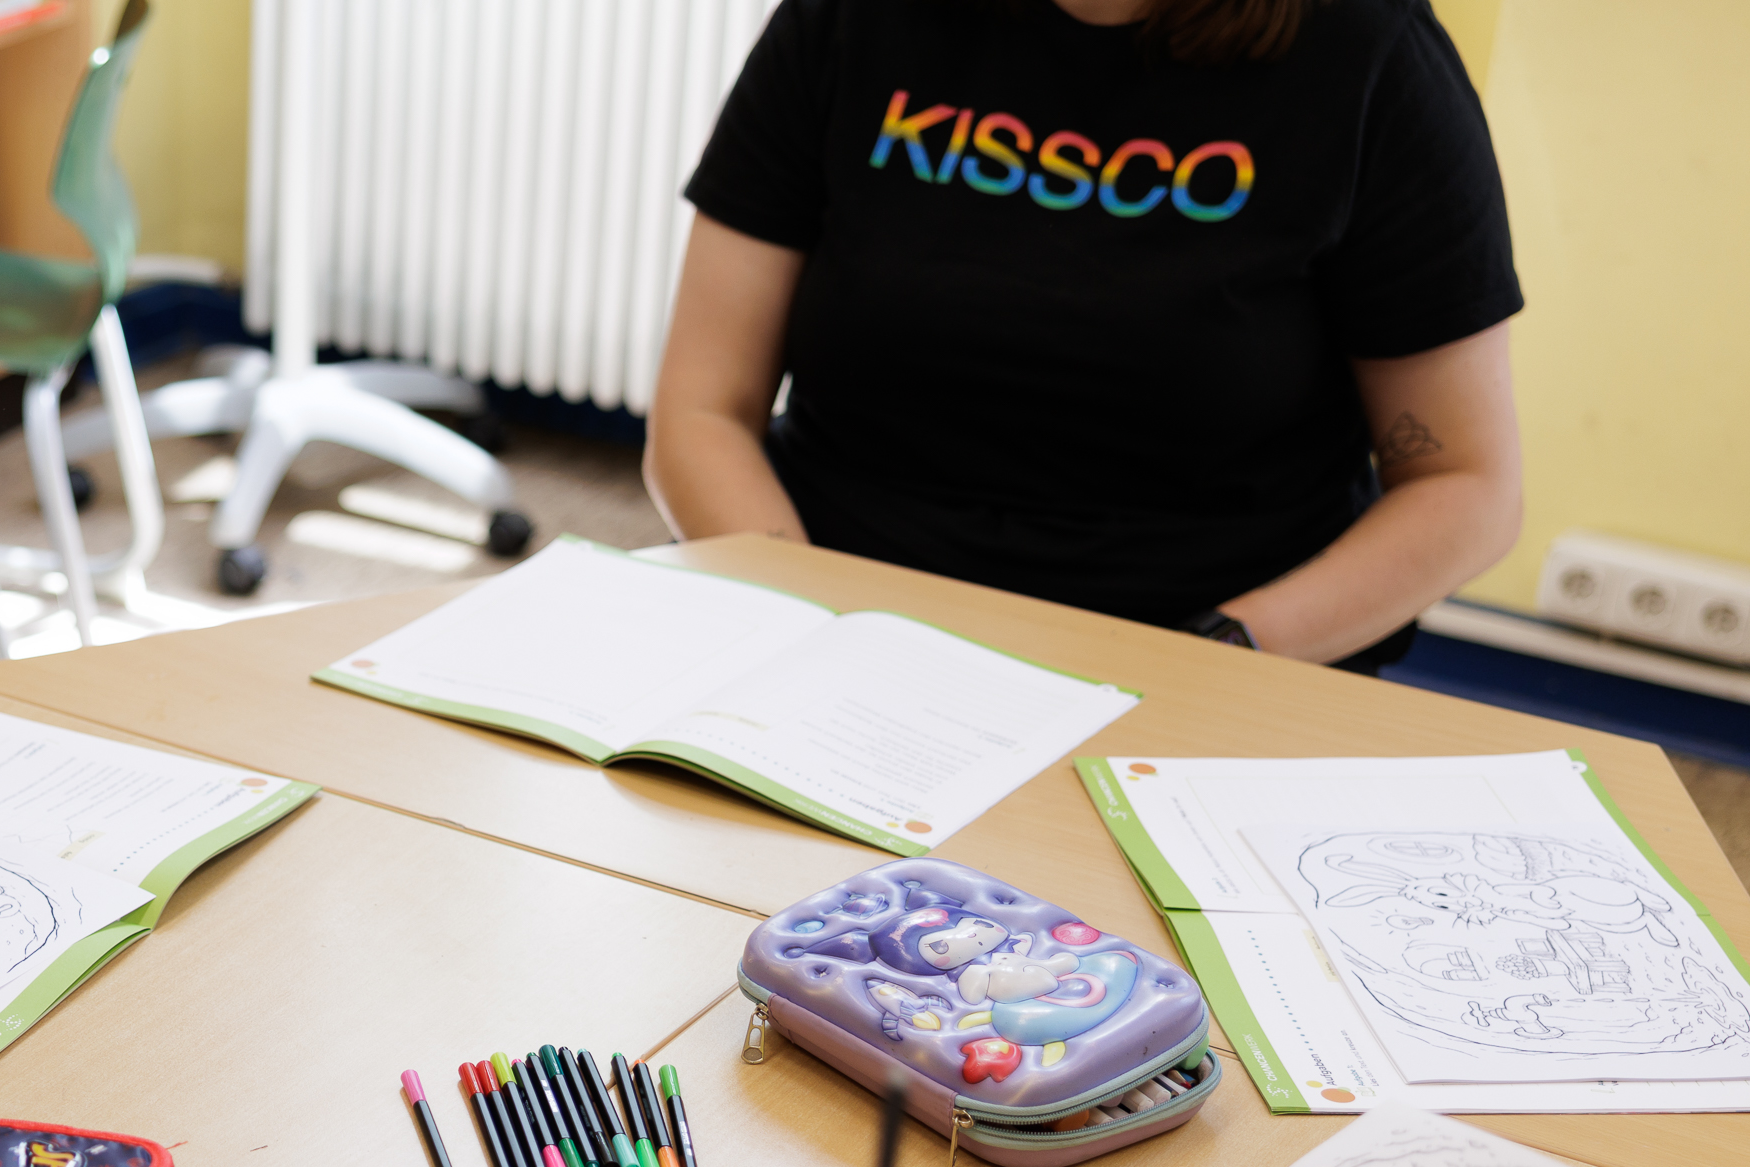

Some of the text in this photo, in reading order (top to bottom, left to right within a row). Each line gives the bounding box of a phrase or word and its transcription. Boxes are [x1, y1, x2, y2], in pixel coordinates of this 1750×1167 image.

[870, 89, 1256, 223] KISSCO
[1241, 1032, 1277, 1083] CHANCENWERK
[1309, 1052, 1336, 1085] Aufgaben
